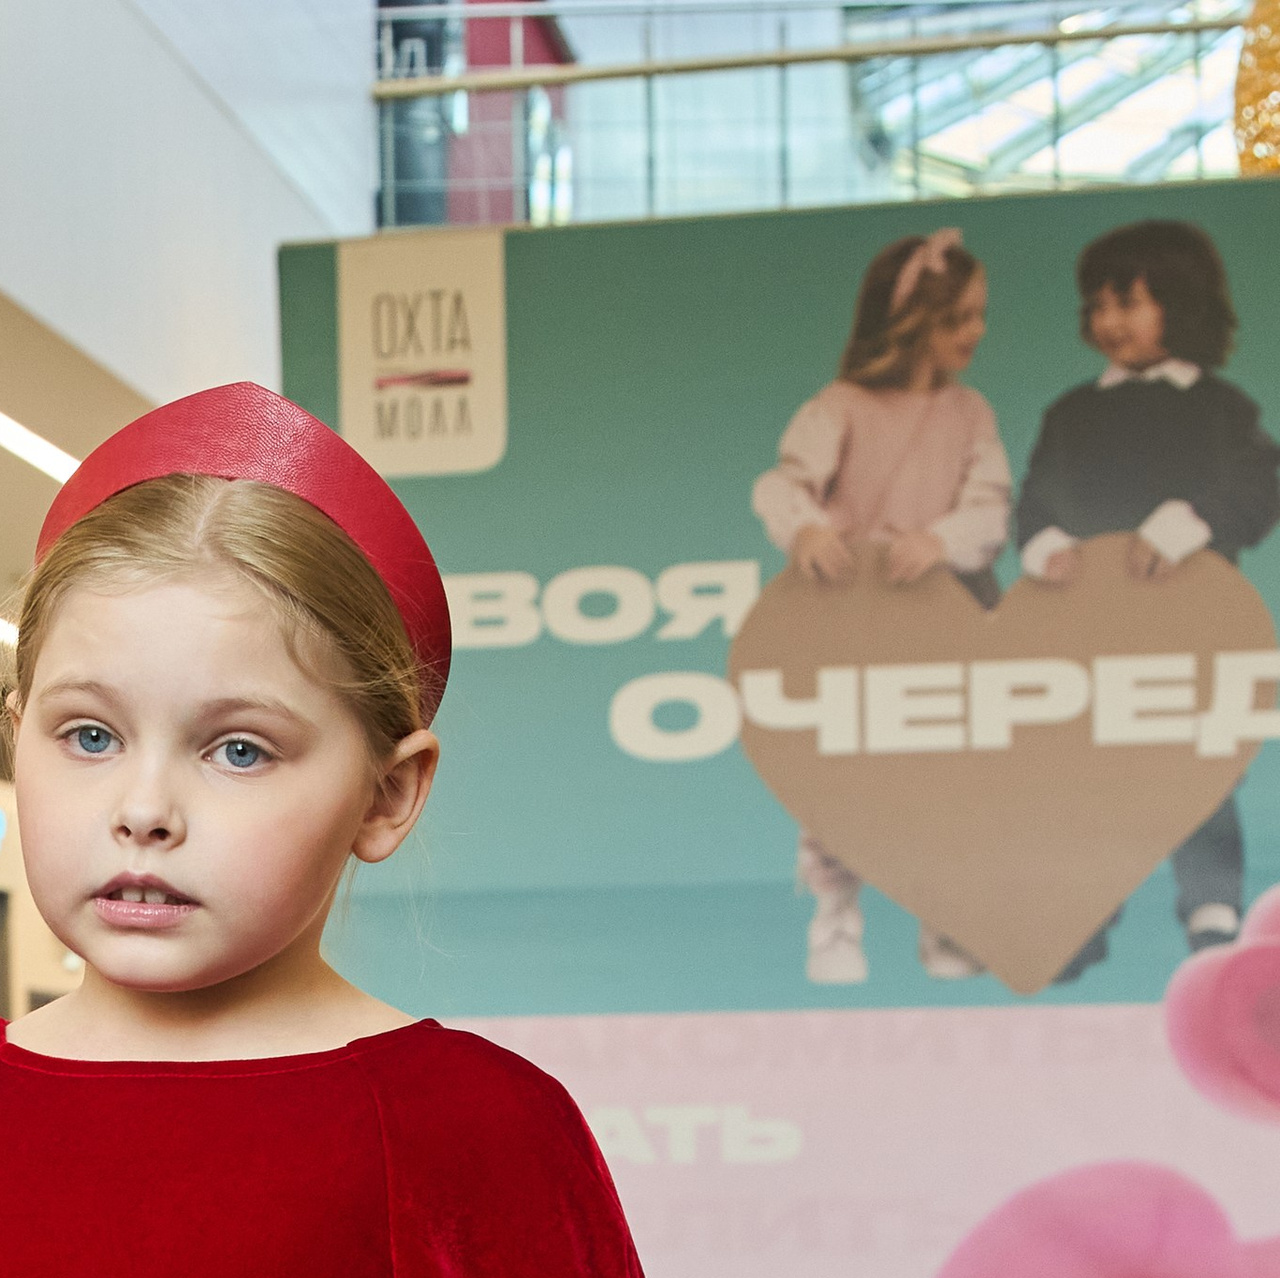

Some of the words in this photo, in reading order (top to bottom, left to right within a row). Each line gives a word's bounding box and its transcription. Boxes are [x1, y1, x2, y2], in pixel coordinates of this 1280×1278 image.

[372, 288, 472, 358] ОХТА
[442, 559, 761, 648] ВОЯ
[587, 1105, 803, 1164] АТЬ
